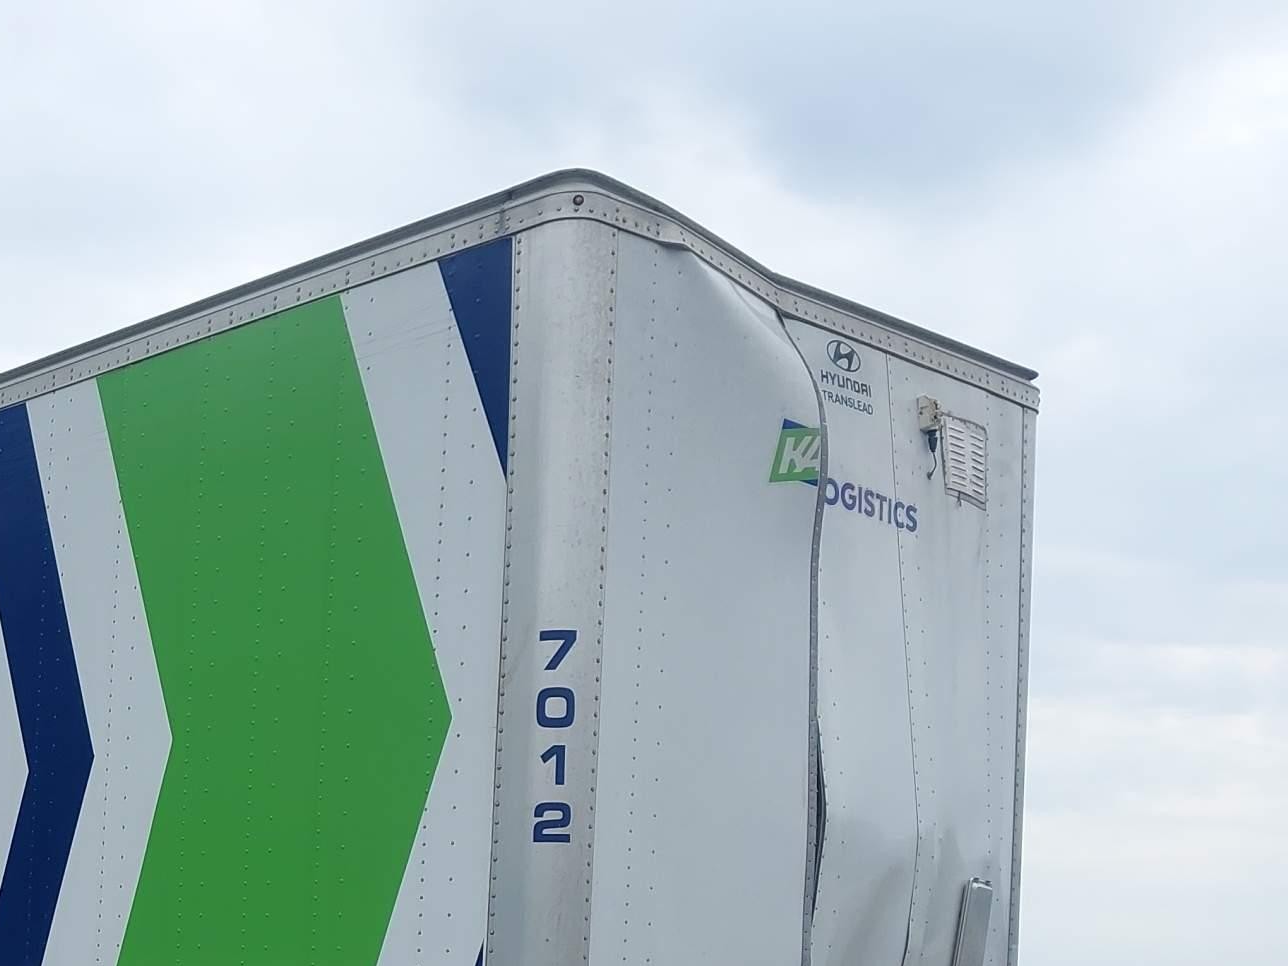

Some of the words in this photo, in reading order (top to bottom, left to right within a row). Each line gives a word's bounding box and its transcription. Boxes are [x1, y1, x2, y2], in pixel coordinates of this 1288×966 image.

[820, 369, 873, 398] HYUNDAI
[822, 389, 874, 416] TRANSLEAD
[824, 477, 918, 533] OGISTICS
[532, 629, 578, 844] 7012
